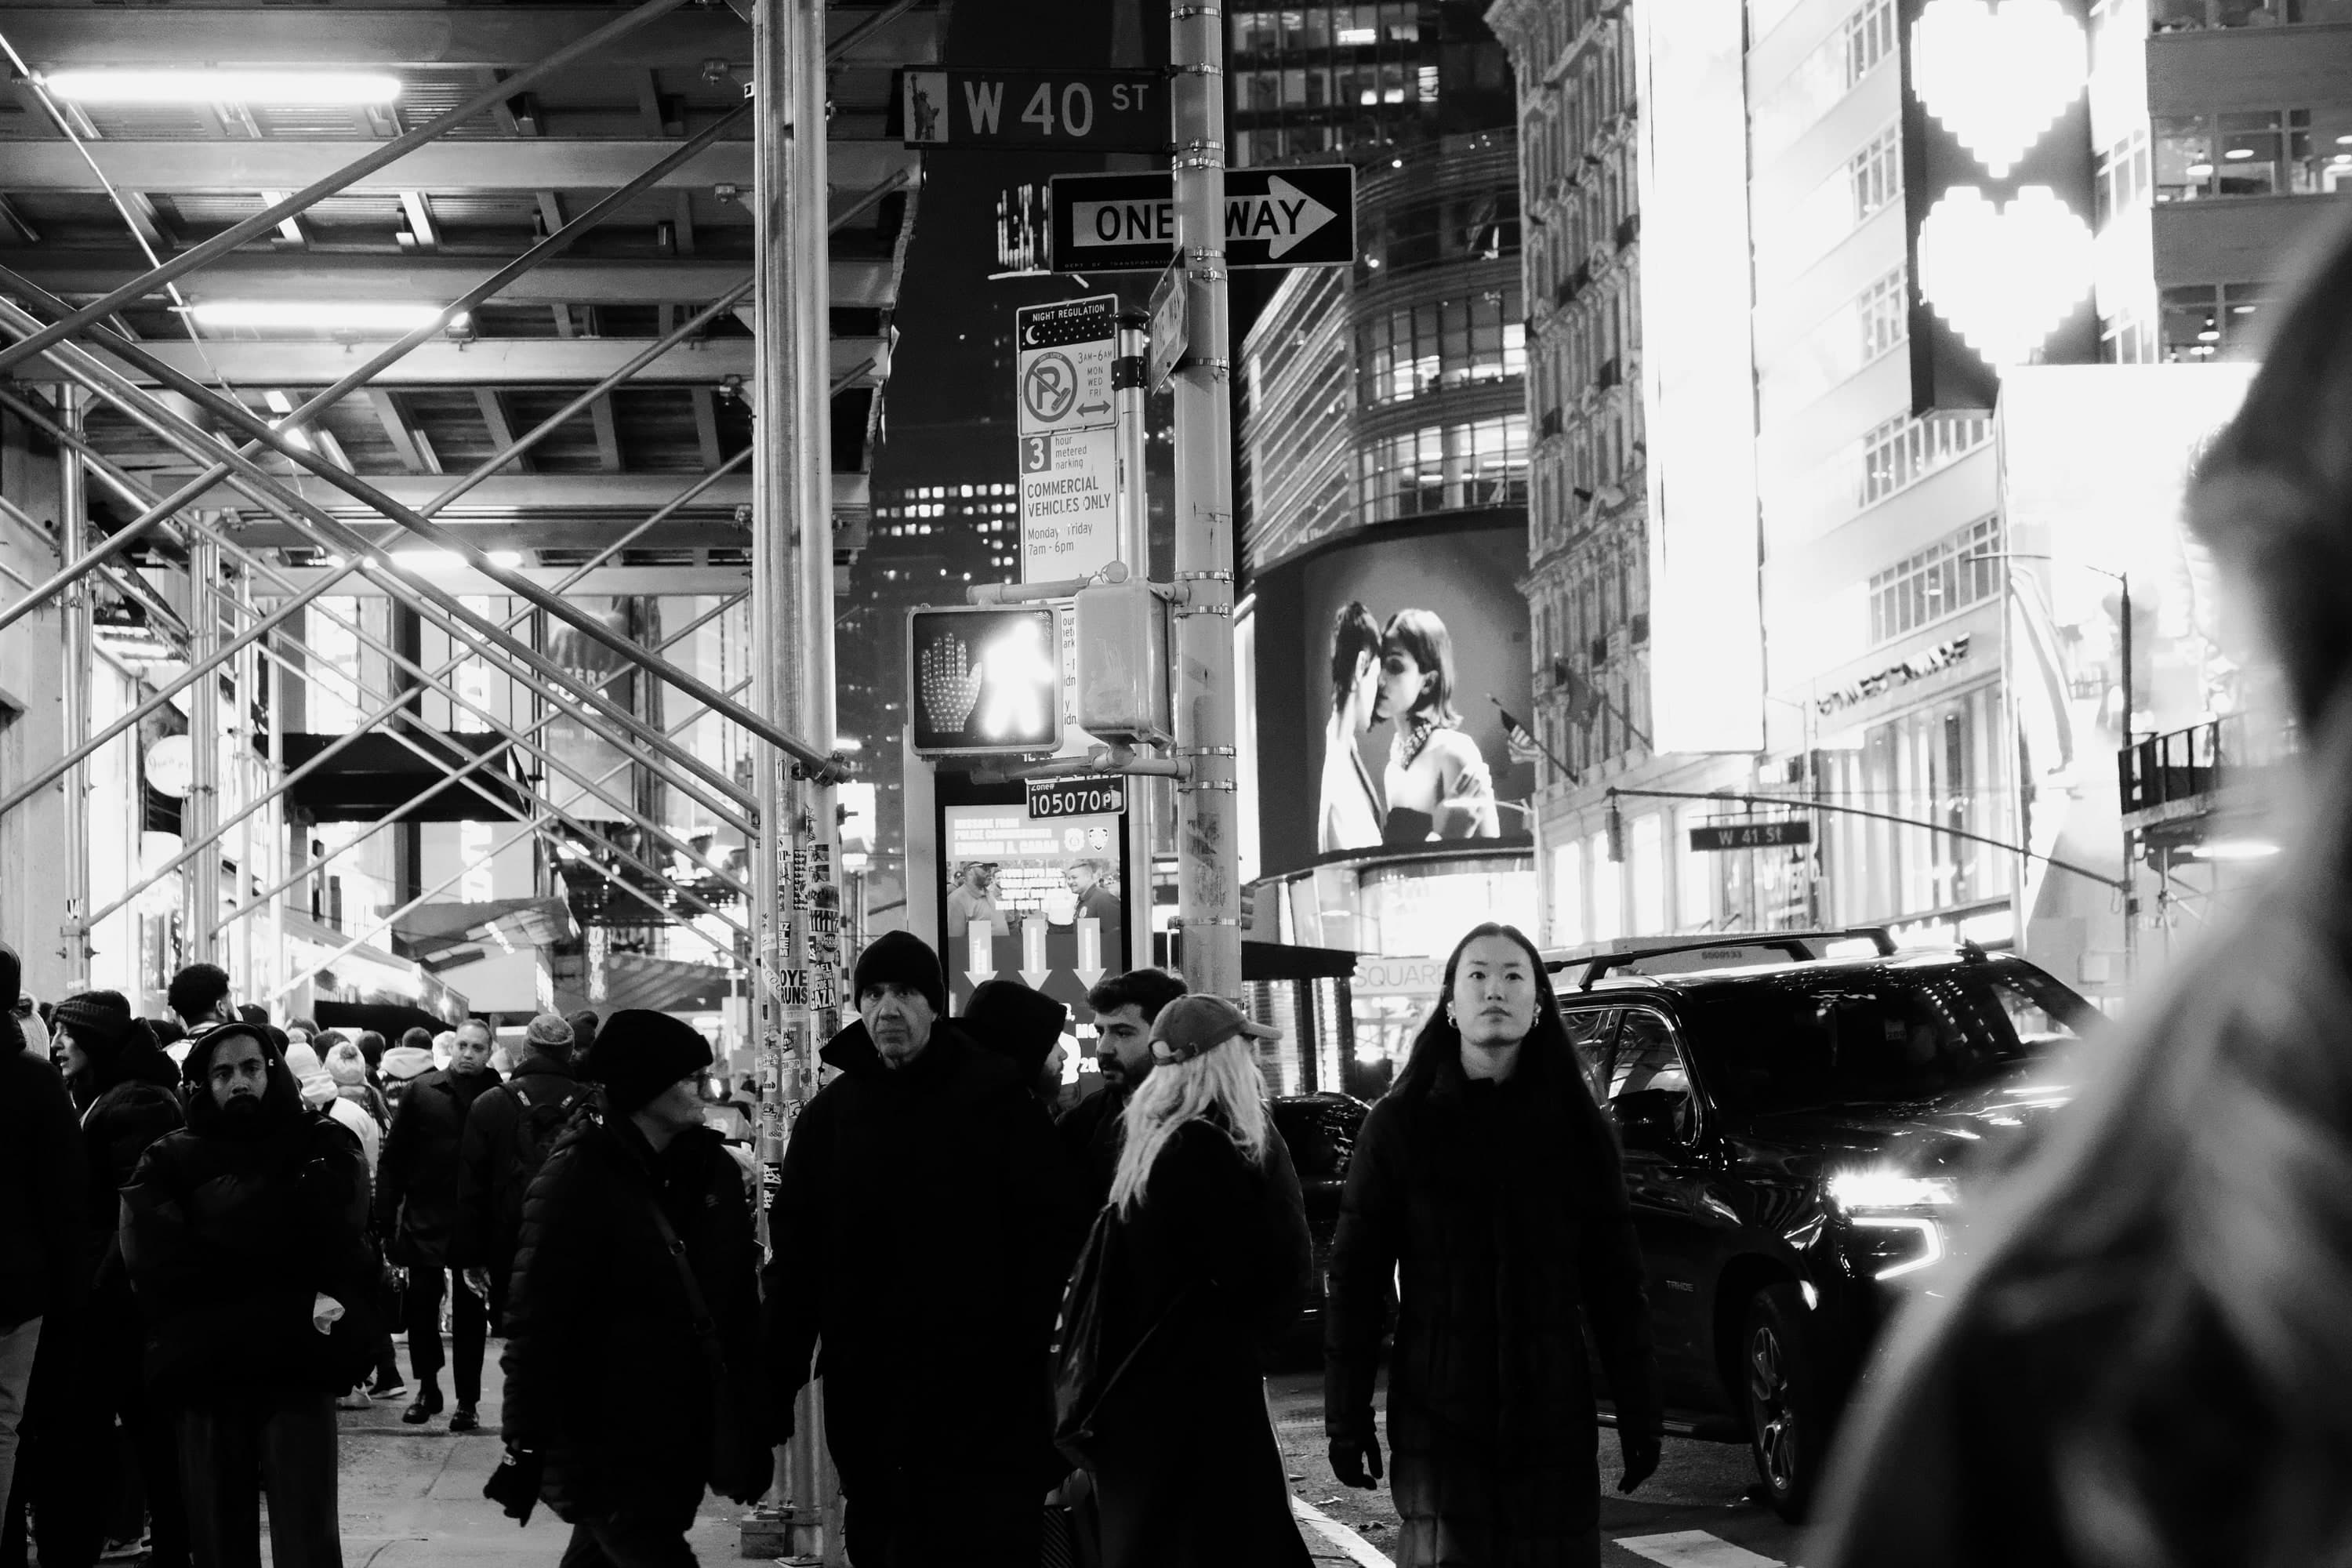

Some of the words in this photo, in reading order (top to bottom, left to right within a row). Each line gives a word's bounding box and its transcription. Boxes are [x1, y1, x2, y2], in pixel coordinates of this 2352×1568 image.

[964, 81, 1004, 134] W
[1022, 82, 1093, 136] 40
[1112, 83, 1149, 111] ST
[1096, 203, 1173, 241] ONE
[1225, 199, 1306, 238] WAY
[1033, 310, 1054, 322] NIGHT
[1058, 303, 1105, 318] REGULATION
[1087, 366, 1103, 376] MON
[1088, 378, 1103, 387] WED
[1055, 436, 1073, 446] hour
[1029, 437, 1044, 470] 3
[1055, 446, 1087, 458] metered
[1027, 476, 1099, 499] COMMERCIAL
[1028, 497, 1080, 517] VEHICLES
[1083, 493, 1111, 510] ONLY
[1028, 527, 1058, 540] Monday
[1028, 544, 1046, 556] 7am
[1054, 541, 1074, 554] 6pm
[1032, 790, 1101, 816] 105070
[1719, 830, 1733, 845] W
[1741, 828, 1758, 844] 41
[1766, 826, 1782, 843] St
[811, 989, 837, 1010] GAZA
